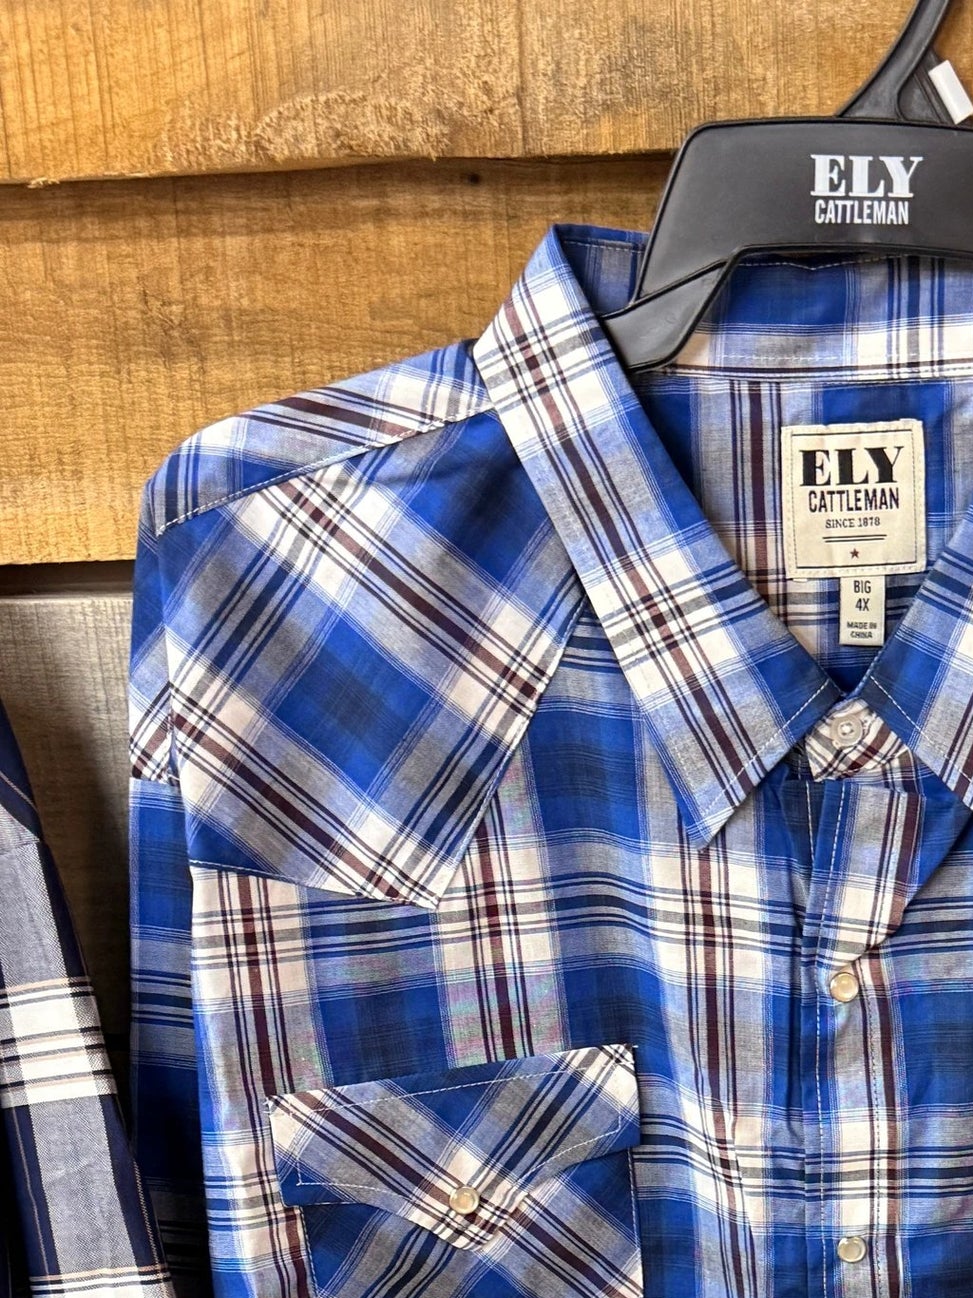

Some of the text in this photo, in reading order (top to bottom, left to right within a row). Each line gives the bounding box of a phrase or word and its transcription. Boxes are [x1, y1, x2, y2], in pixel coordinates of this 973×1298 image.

[810, 154, 923, 198] ELY
[814, 199, 909, 225] CATTLEMAN
[799, 446, 905, 487] ELY
[808, 486, 900, 513] CATTLEMAN
[825, 516, 881, 529] SINCE 1878
[853, 579, 872, 594] BIG
[855, 597, 870, 612] 4X
[846, 621, 878, 630] MADE IN
[850, 630, 873, 639] CHINA
